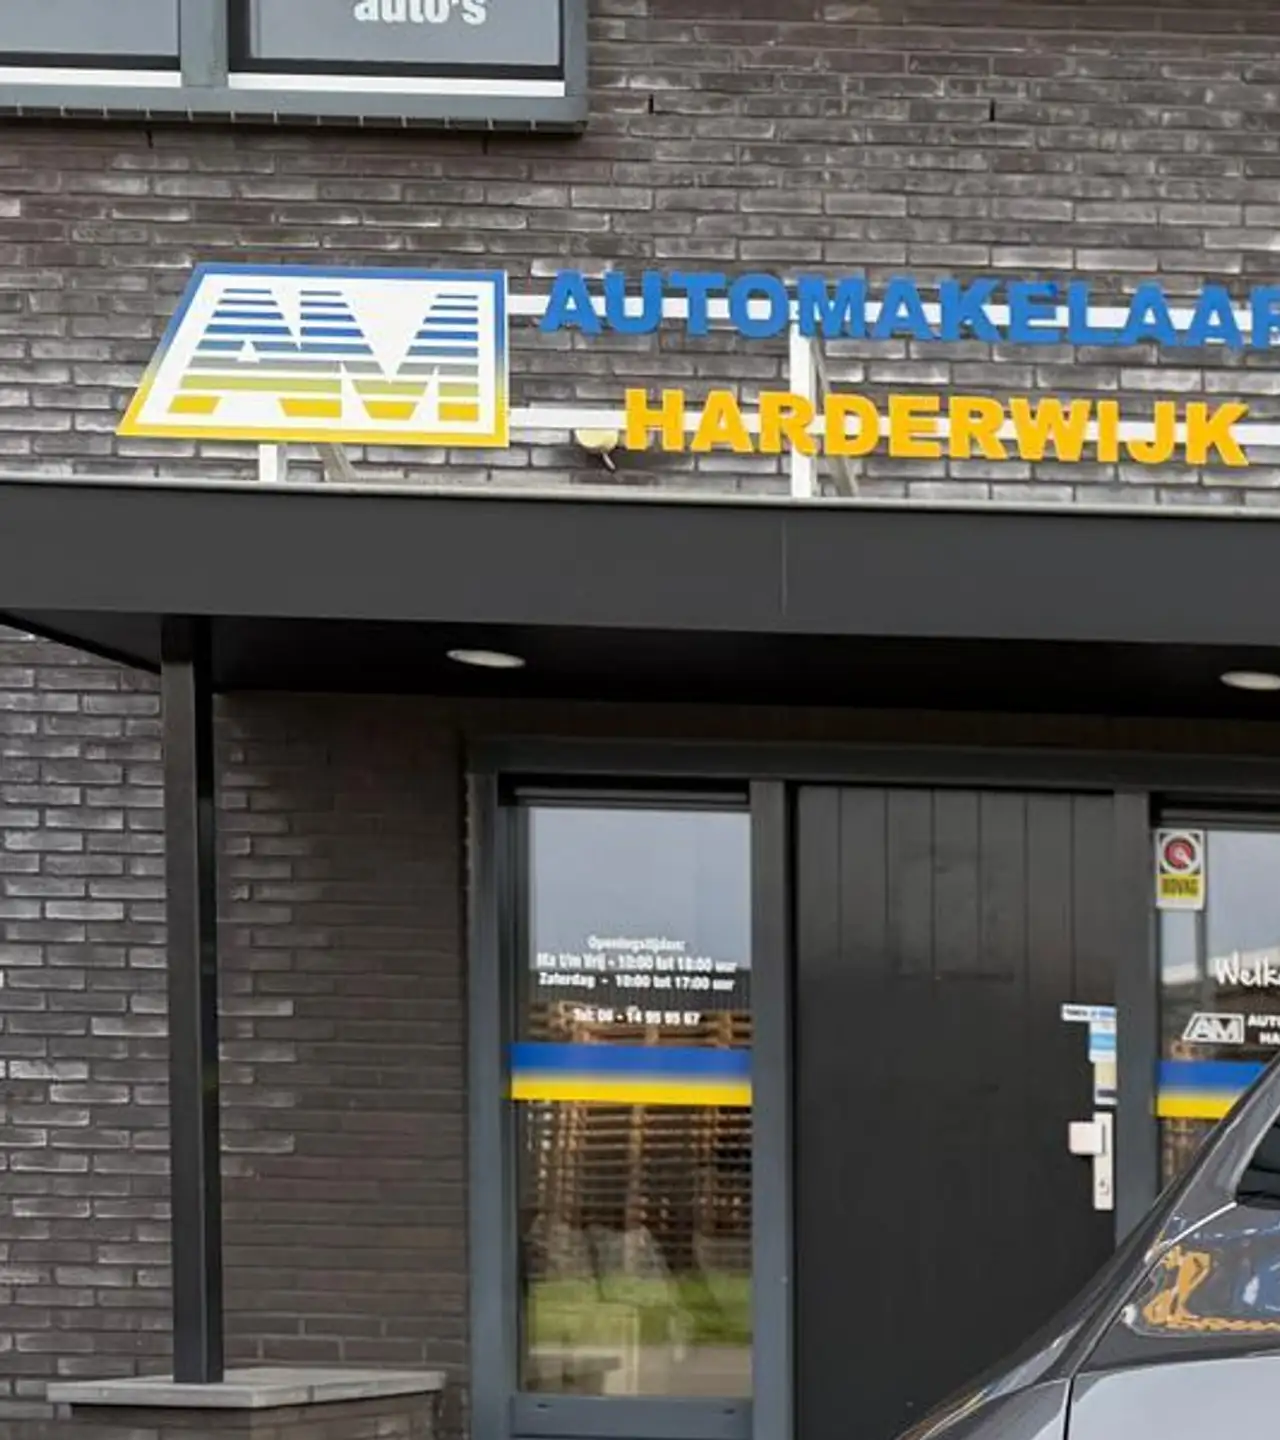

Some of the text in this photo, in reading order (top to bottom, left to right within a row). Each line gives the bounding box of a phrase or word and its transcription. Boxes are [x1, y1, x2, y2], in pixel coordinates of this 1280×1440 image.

[166, 287, 481, 421] AM
[624, 388, 1250, 467] HARDERWIJK
[538, 972, 596, 988] Zaterdag
